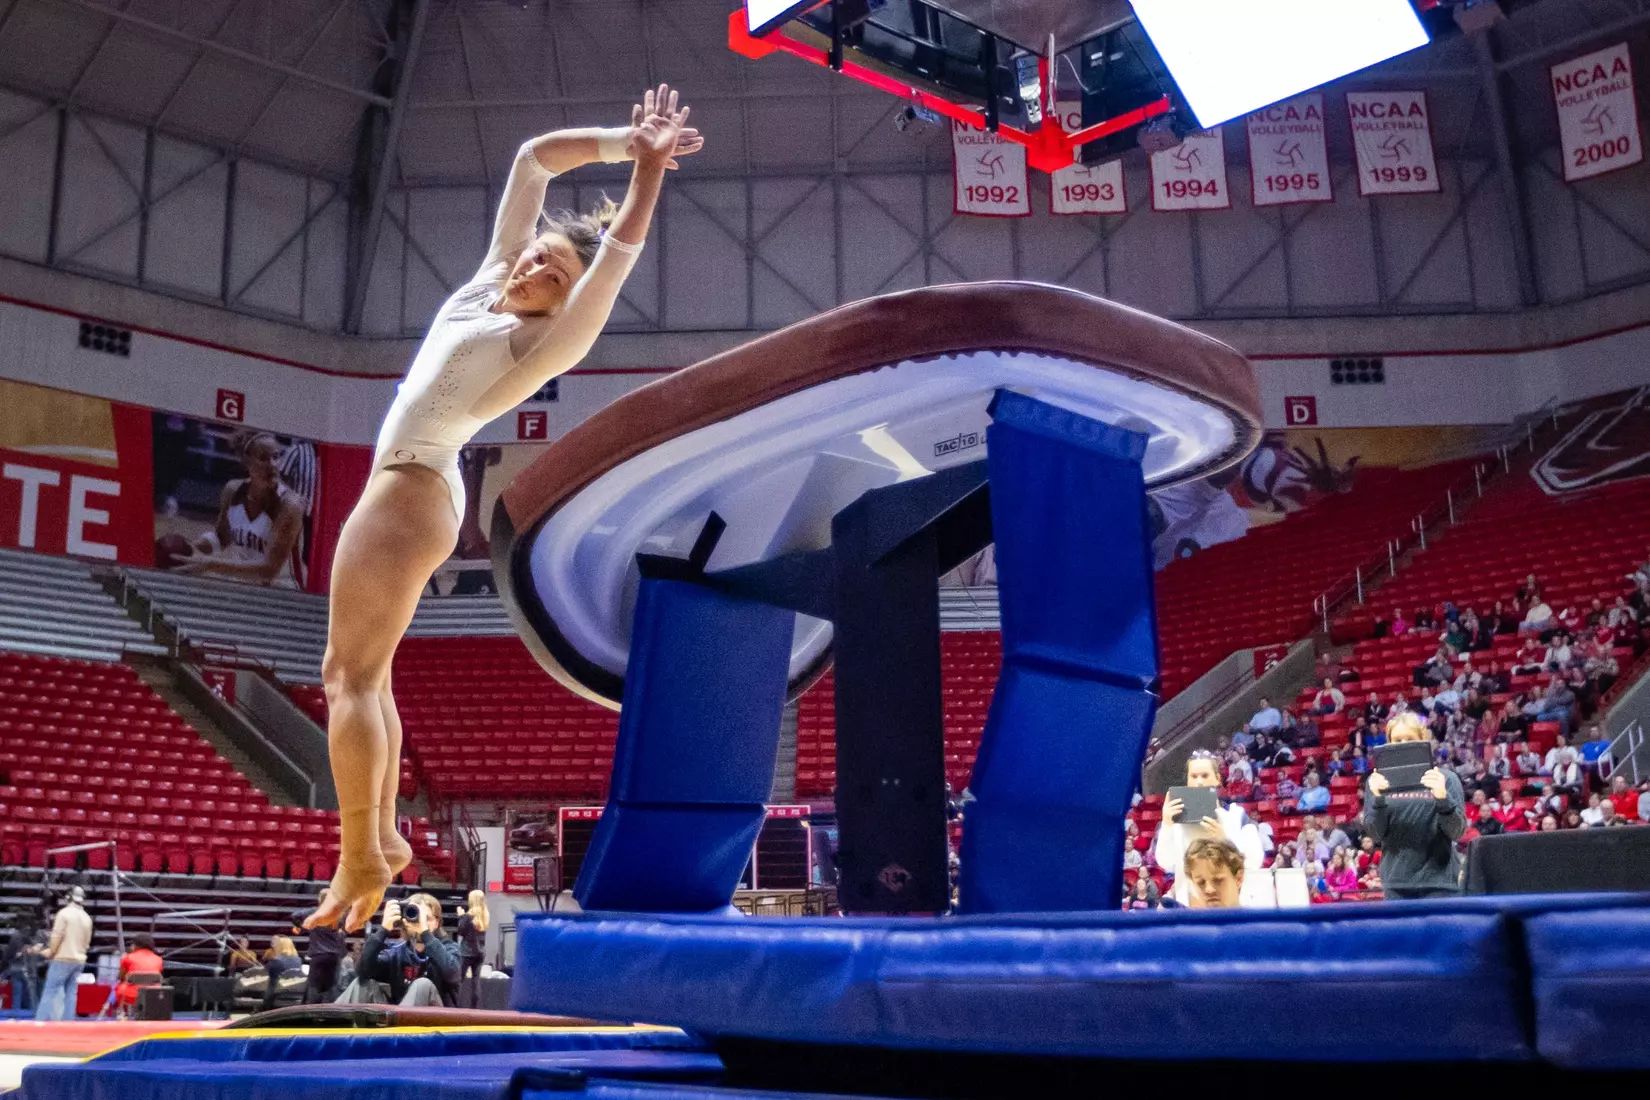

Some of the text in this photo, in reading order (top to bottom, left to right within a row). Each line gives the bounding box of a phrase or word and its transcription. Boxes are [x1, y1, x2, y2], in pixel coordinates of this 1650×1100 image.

[1555, 57, 1628, 95] NCAA
[1559, 80, 1630, 108] VOLLEYBALL
[1350, 102, 1423, 118] NCAA
[1252, 124, 1320, 135] VOLLEYBALL
[1354, 121, 1425, 131] VOLLEYBALL
[1574, 136, 1630, 167] 2000
[1264, 172, 1320, 193] 1995
[1369, 166, 1427, 183] 1999
[965, 185, 1020, 203] 1992
[1062, 183, 1115, 202] 1993
[1162, 179, 1219, 198] 1994
[223, 398, 238, 418] G
[1292, 404, 1309, 423] D
[525, 419, 540, 437] F
[3, 463, 121, 560] TE
